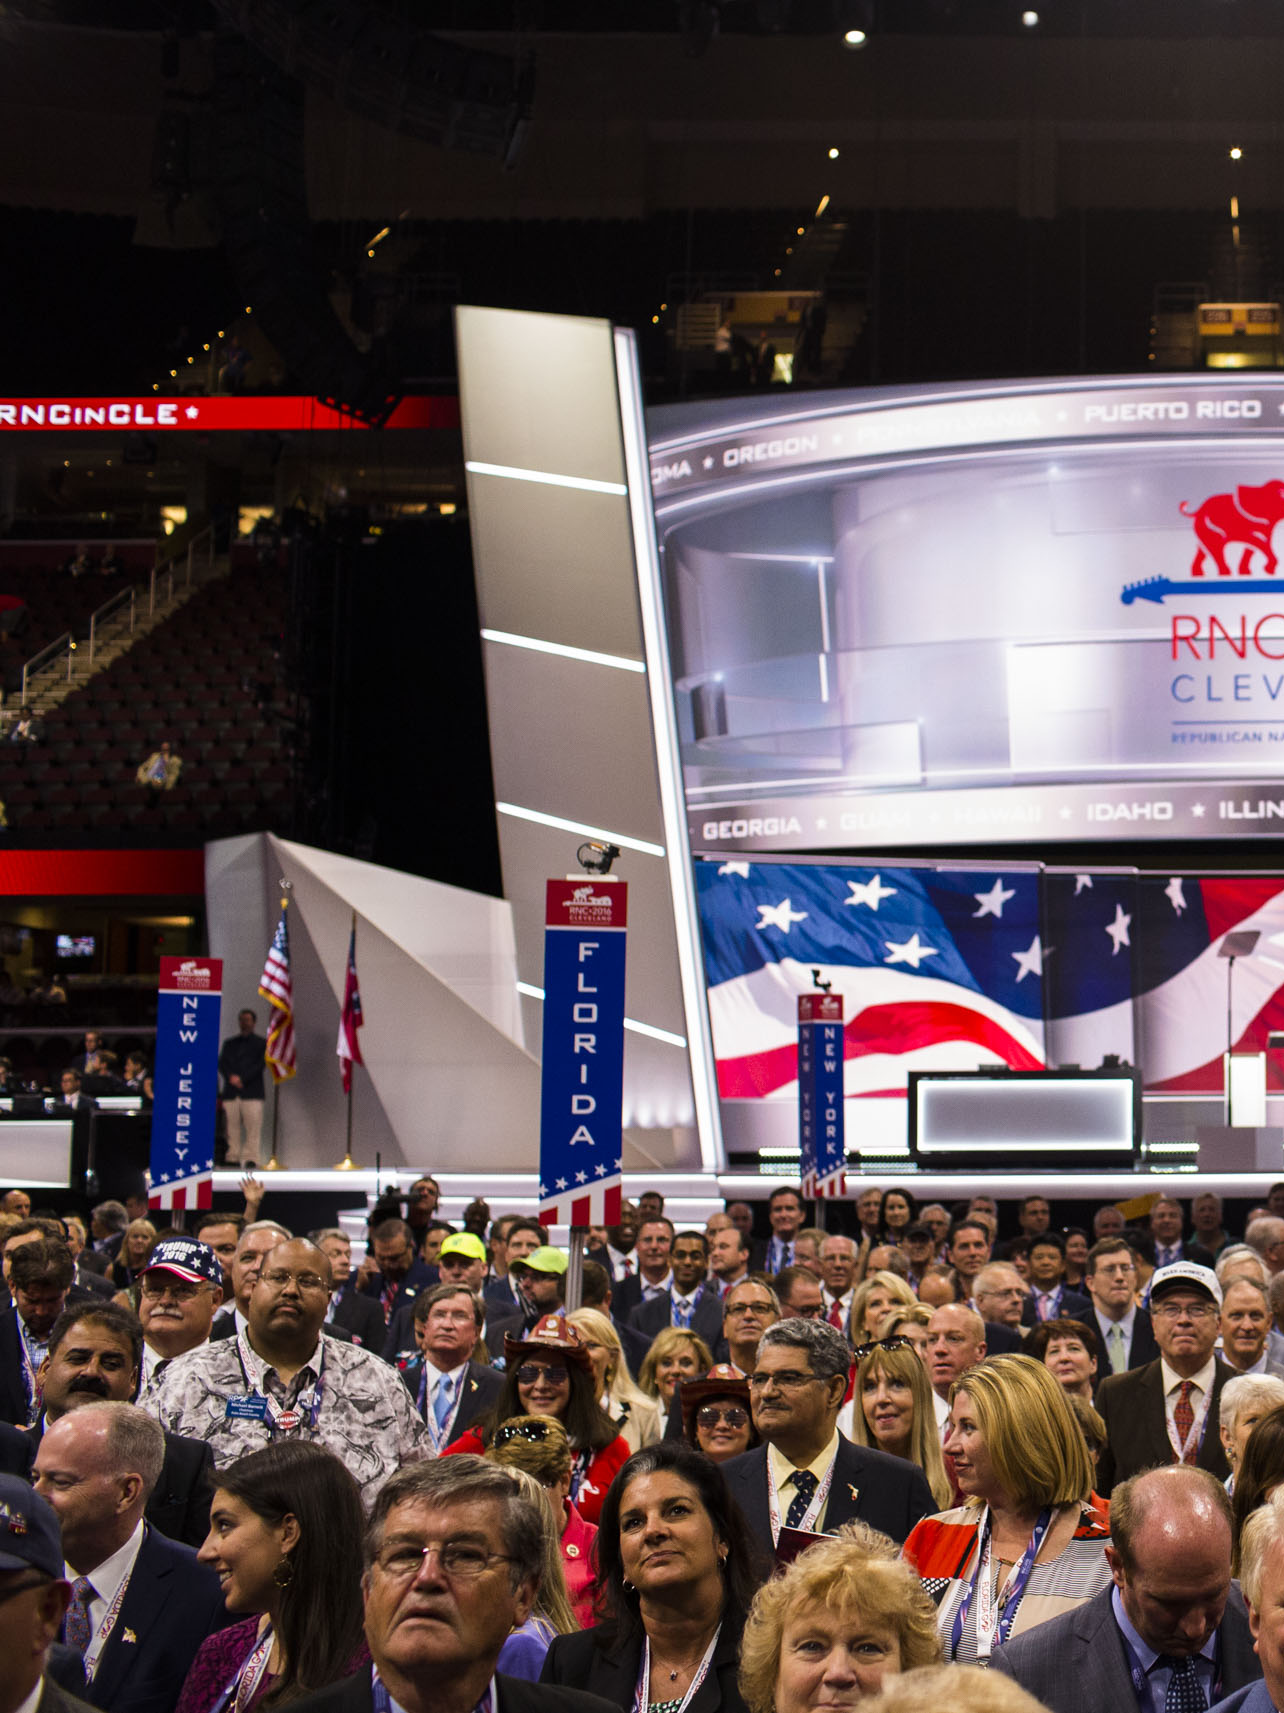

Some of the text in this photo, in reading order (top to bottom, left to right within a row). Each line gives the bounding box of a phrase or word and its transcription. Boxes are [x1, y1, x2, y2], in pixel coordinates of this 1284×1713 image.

[723, 434, 818, 469] OREGON
[1084, 401, 1189, 423] PUERTO
[1196, 400, 1263, 419] RICO
[1171, 731, 1262, 744] REPUBLICAN
[703, 816, 801, 840] GEORGIA
[1087, 801, 1173, 820] IDAHO
[179, 996, 198, 1043] NEW
[569, 942, 600, 1145] FLORIDA
[824, 1028, 836, 1072] NEW
[174, 1062, 193, 1161] JERSEY
[825, 1092, 837, 1154] YORK
[161, 1251, 187, 1262] 2016
[162, 1241, 197, 1254] TRUMP
[981, 1582, 990, 1616] FLORIDA
